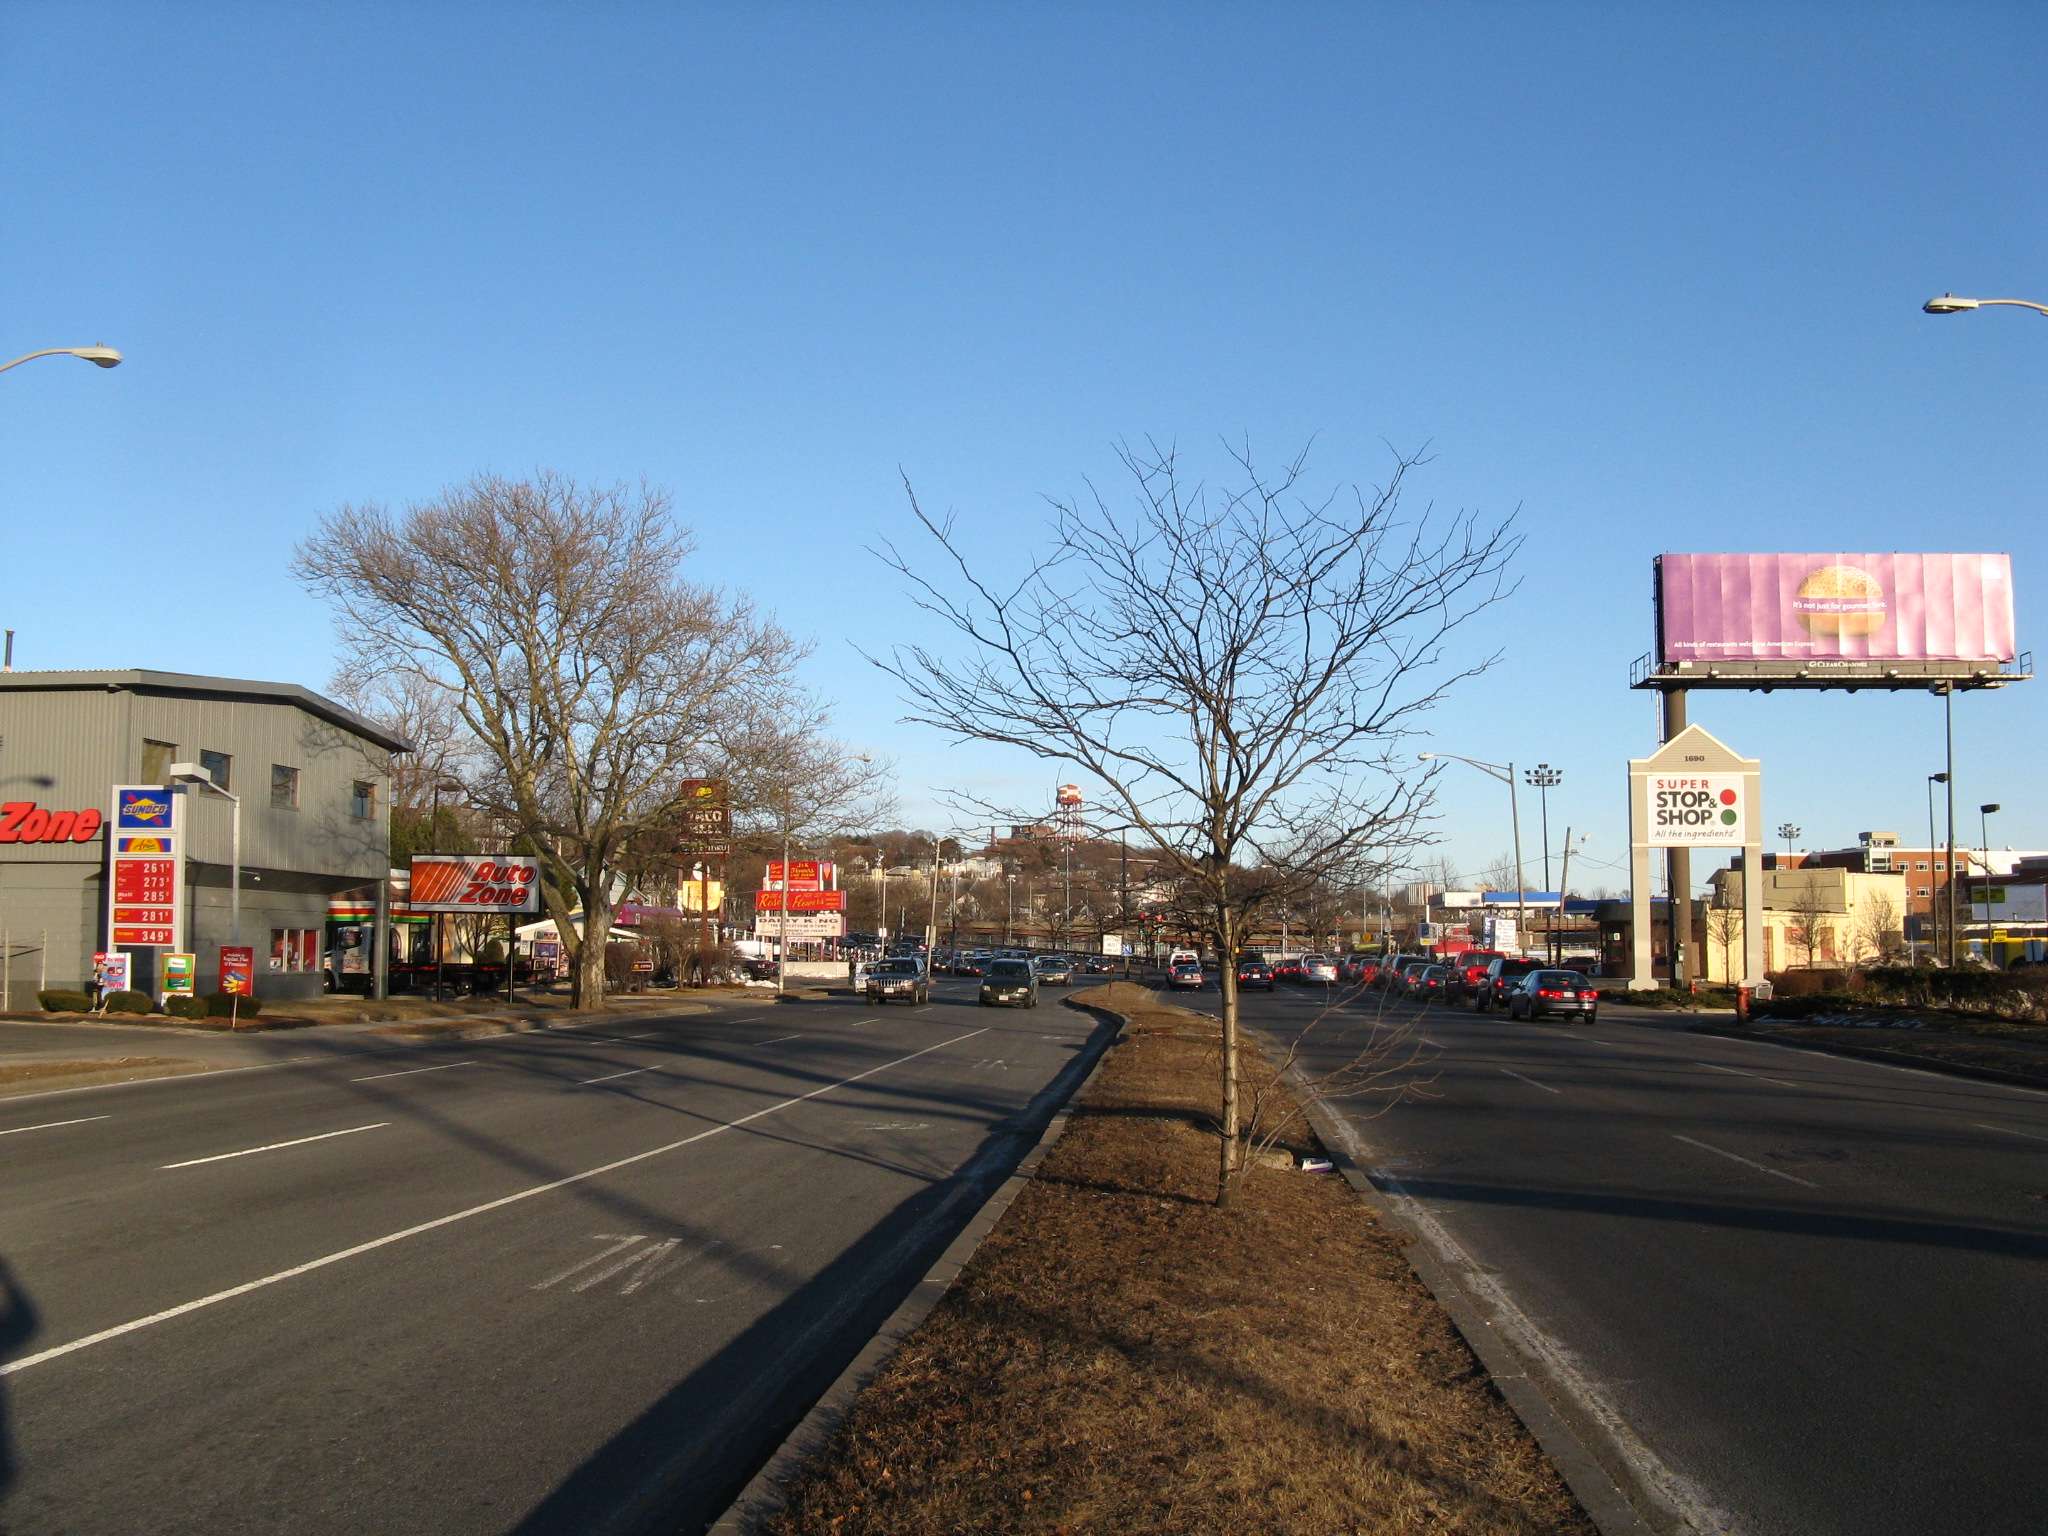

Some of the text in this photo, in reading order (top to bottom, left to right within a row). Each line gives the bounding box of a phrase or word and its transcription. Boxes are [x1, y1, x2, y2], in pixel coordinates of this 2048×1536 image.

[1816, 601, 1830, 611] just
[1657, 779, 1709, 789] SUPER
[1656, 791, 1710, 808] STOP
[123, 804, 168, 815] SUNOCO
[1656, 809, 1713, 826] SHOP
[0, 802, 101, 844] Zone
[1655, 830, 1666, 838] All
[1668, 829, 1682, 838] the
[471, 862, 537, 885] Auto
[459, 882, 529, 906] Zone
